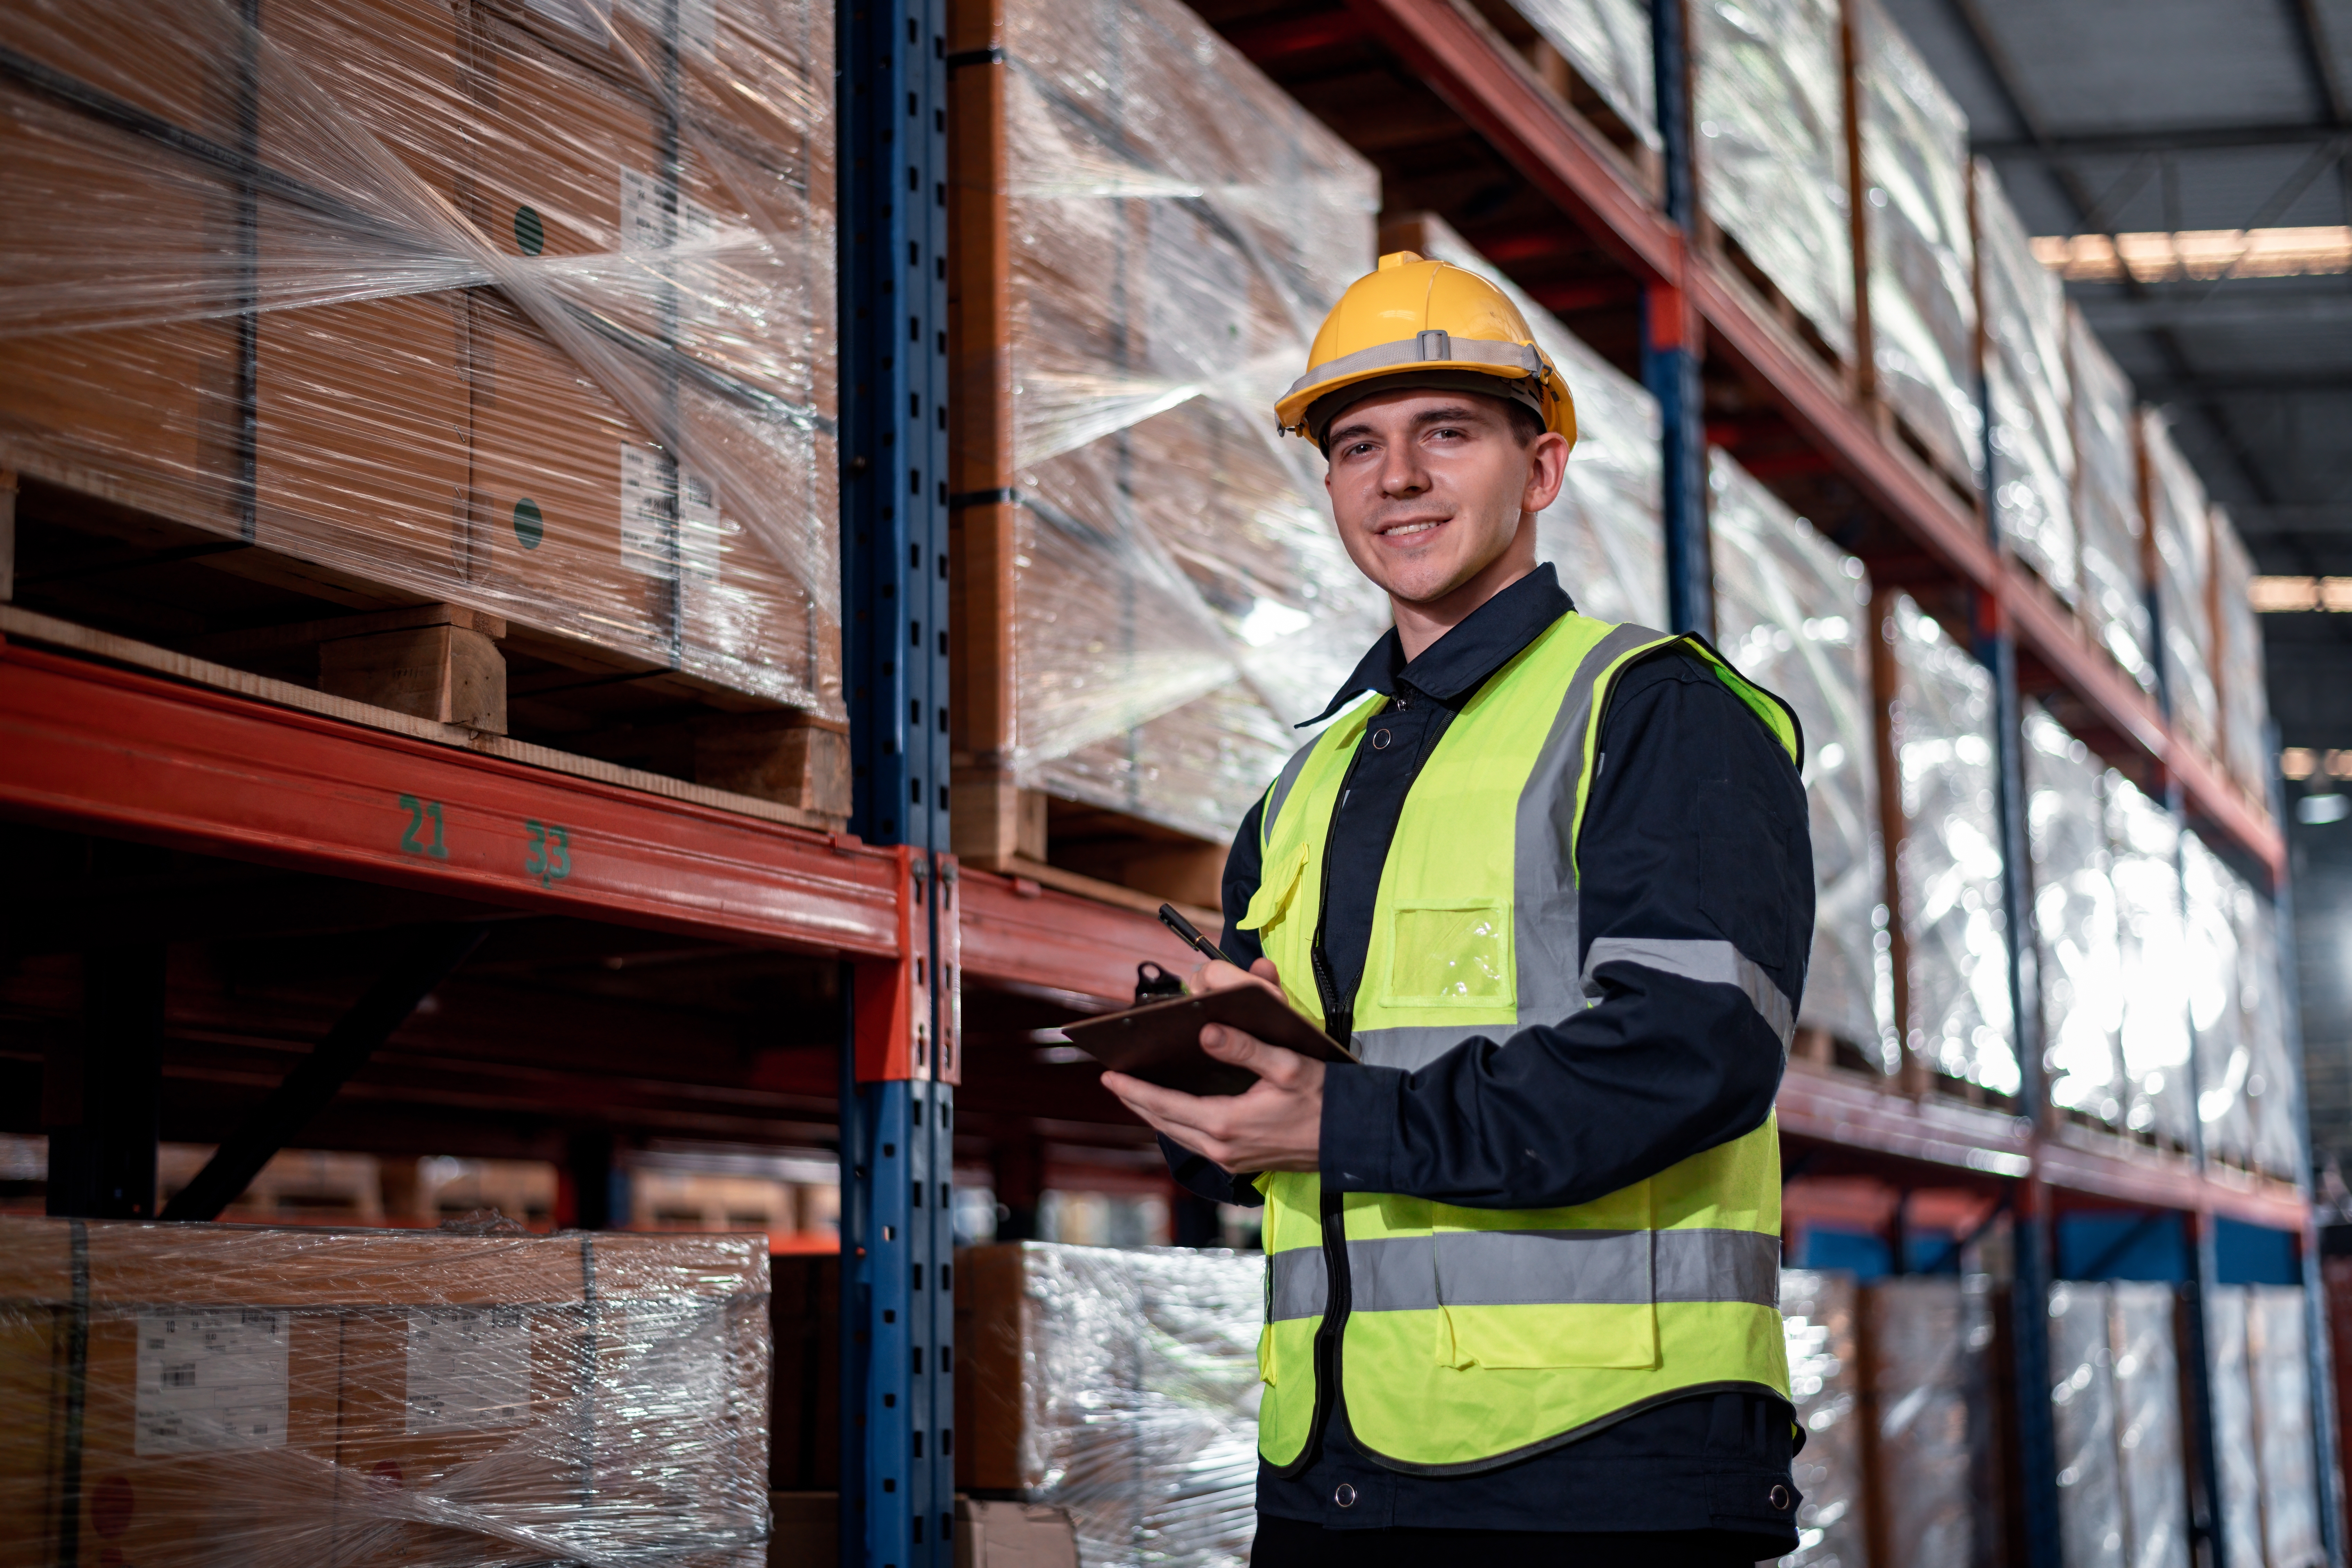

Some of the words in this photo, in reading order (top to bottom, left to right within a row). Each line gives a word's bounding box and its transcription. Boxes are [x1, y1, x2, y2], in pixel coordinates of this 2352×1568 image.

[400, 794, 448, 859] 21
[526, 819, 571, 879] 33
[430, 1314, 438, 1325] 10
[166, 1321, 175, 1333] 10
